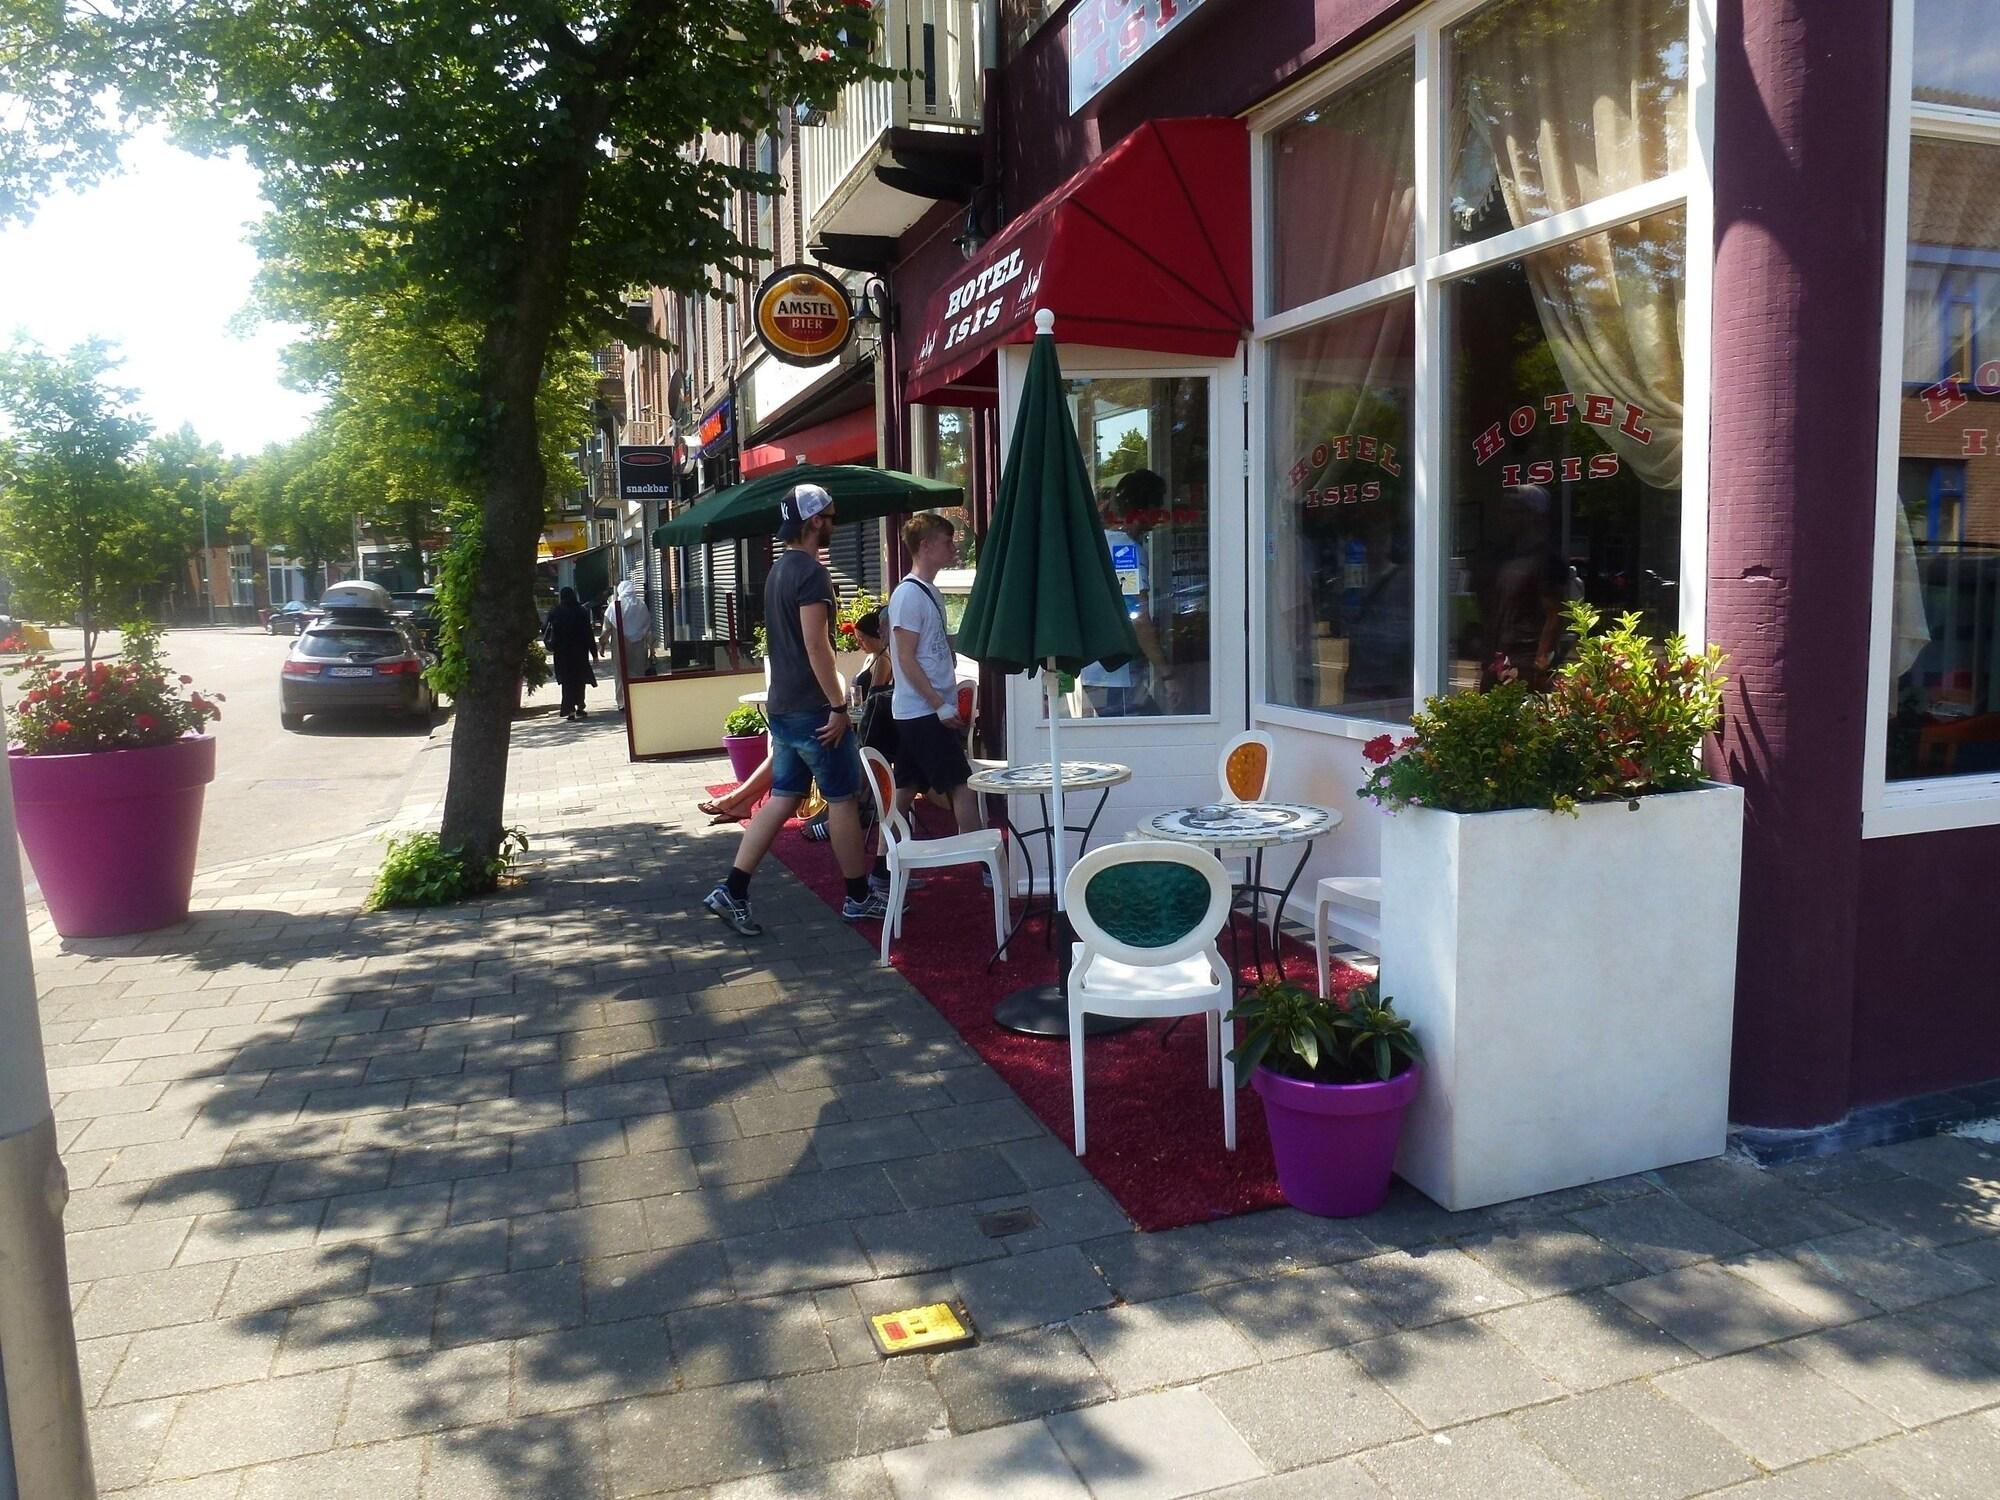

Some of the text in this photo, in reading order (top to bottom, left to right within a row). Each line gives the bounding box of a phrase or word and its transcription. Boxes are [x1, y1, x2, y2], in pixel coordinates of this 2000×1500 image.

[944, 248, 1024, 320] HOTEL
[777, 300, 835, 316] AMSTEL
[792, 319, 823, 329] BIER
[944, 297, 1003, 350] ISIS
[1472, 393, 1653, 466] HOTEL
[1288, 434, 1401, 488] HOTEL
[1503, 453, 1619, 488] ISIS
[626, 483, 669, 493] snackbar
[1306, 481, 1381, 508] ISIS
